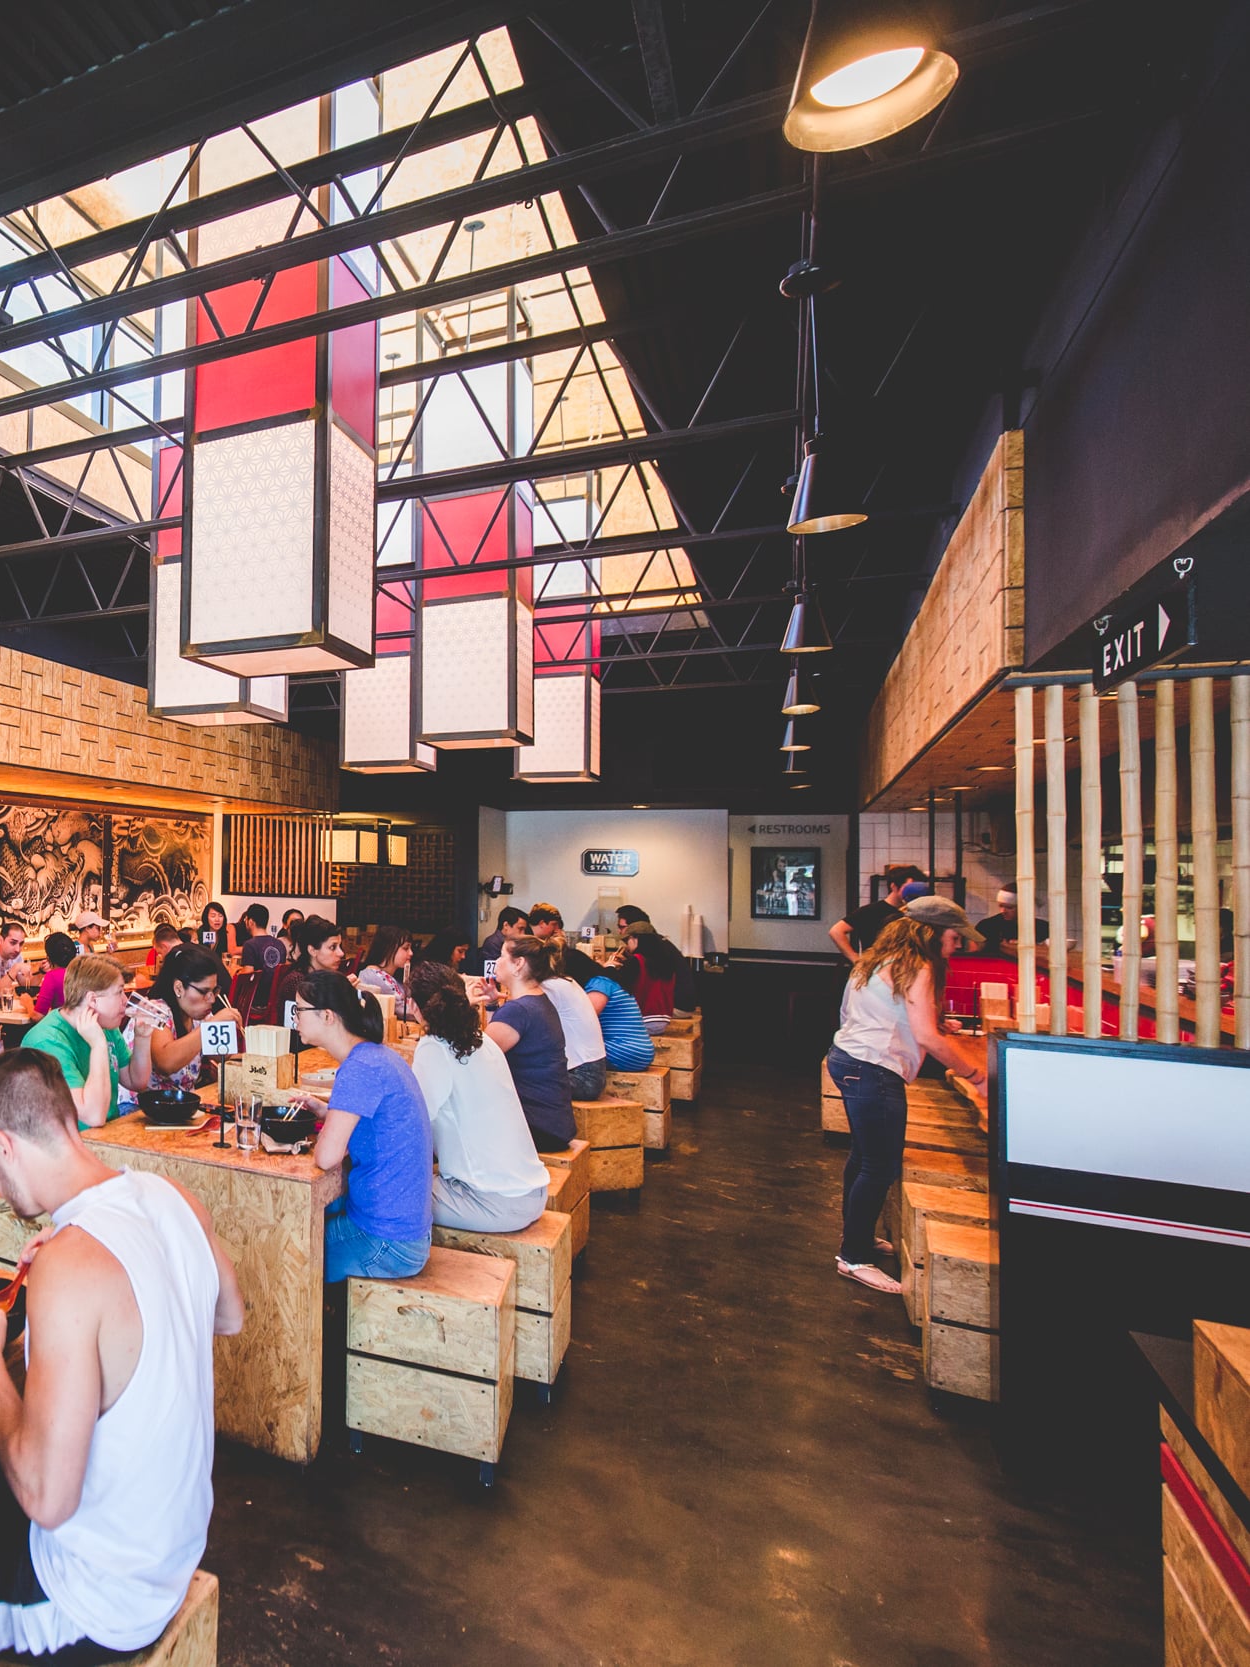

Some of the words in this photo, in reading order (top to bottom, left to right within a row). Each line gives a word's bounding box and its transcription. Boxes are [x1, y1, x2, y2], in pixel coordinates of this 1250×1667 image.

[1103, 620, 1144, 677] EXIT
[759, 825, 831, 834] RESTROOMS
[590, 854, 631, 864] WATER
[486, 962, 496, 974] 27
[207, 1025, 230, 1045] 35
